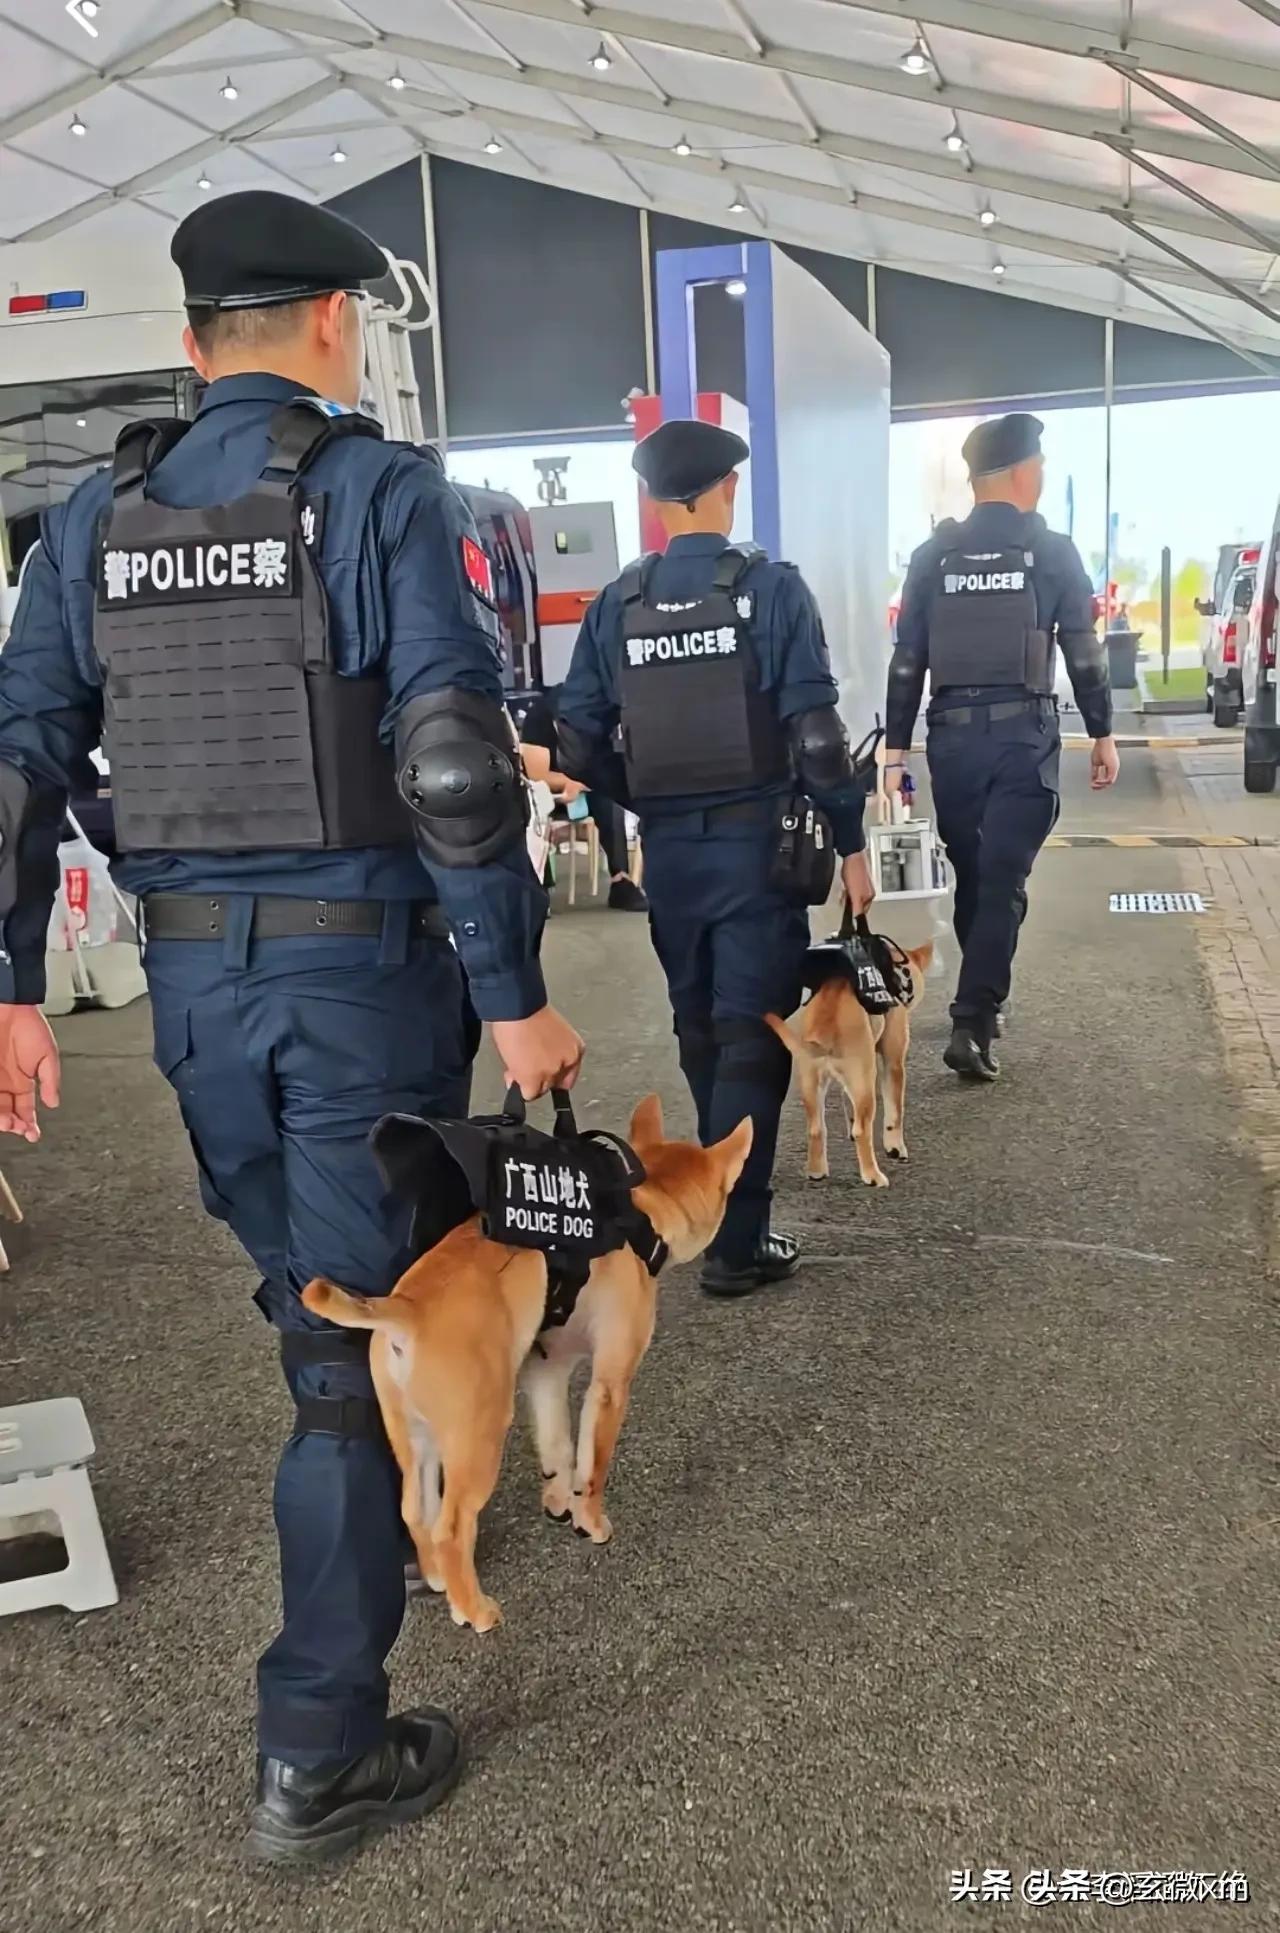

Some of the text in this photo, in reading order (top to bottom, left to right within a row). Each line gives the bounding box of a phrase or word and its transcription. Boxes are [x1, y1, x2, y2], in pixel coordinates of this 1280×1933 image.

[504, 1157, 592, 1211] 广西山地犬
[505, 1206, 594, 1238] POLICE DOG
